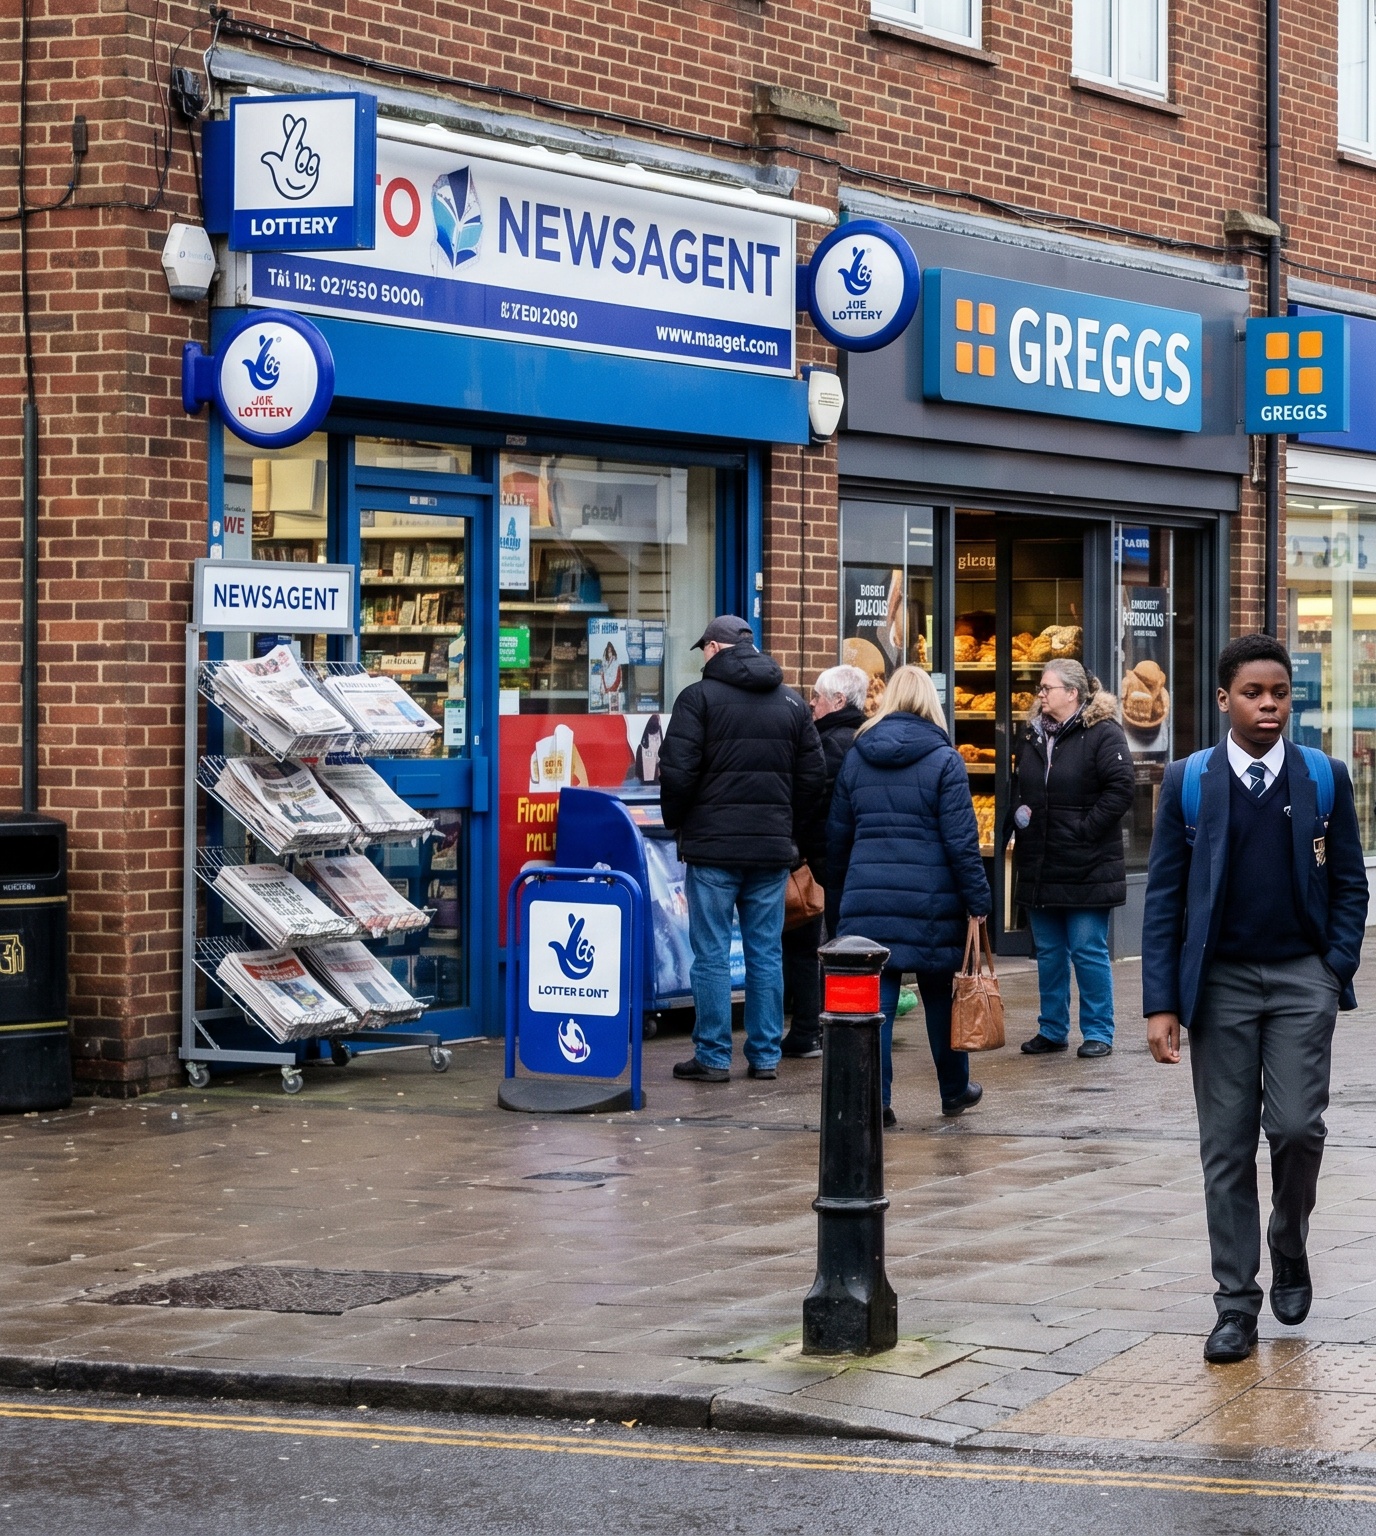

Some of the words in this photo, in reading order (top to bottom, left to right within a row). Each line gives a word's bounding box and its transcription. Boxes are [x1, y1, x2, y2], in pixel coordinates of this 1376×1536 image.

[251, 216, 338, 236] LOTTERY
[499, 196, 780, 296] NEWSAGENT
[832, 310, 882, 320] LOTTERY
[656, 325, 778, 356] www.maaget.com
[1009, 307, 1191, 405] GREGGS
[238, 407, 293, 418] LOTTERY
[1261, 404, 1327, 421] GREGGS
[214, 584, 339, 611] NEWSAGENT
